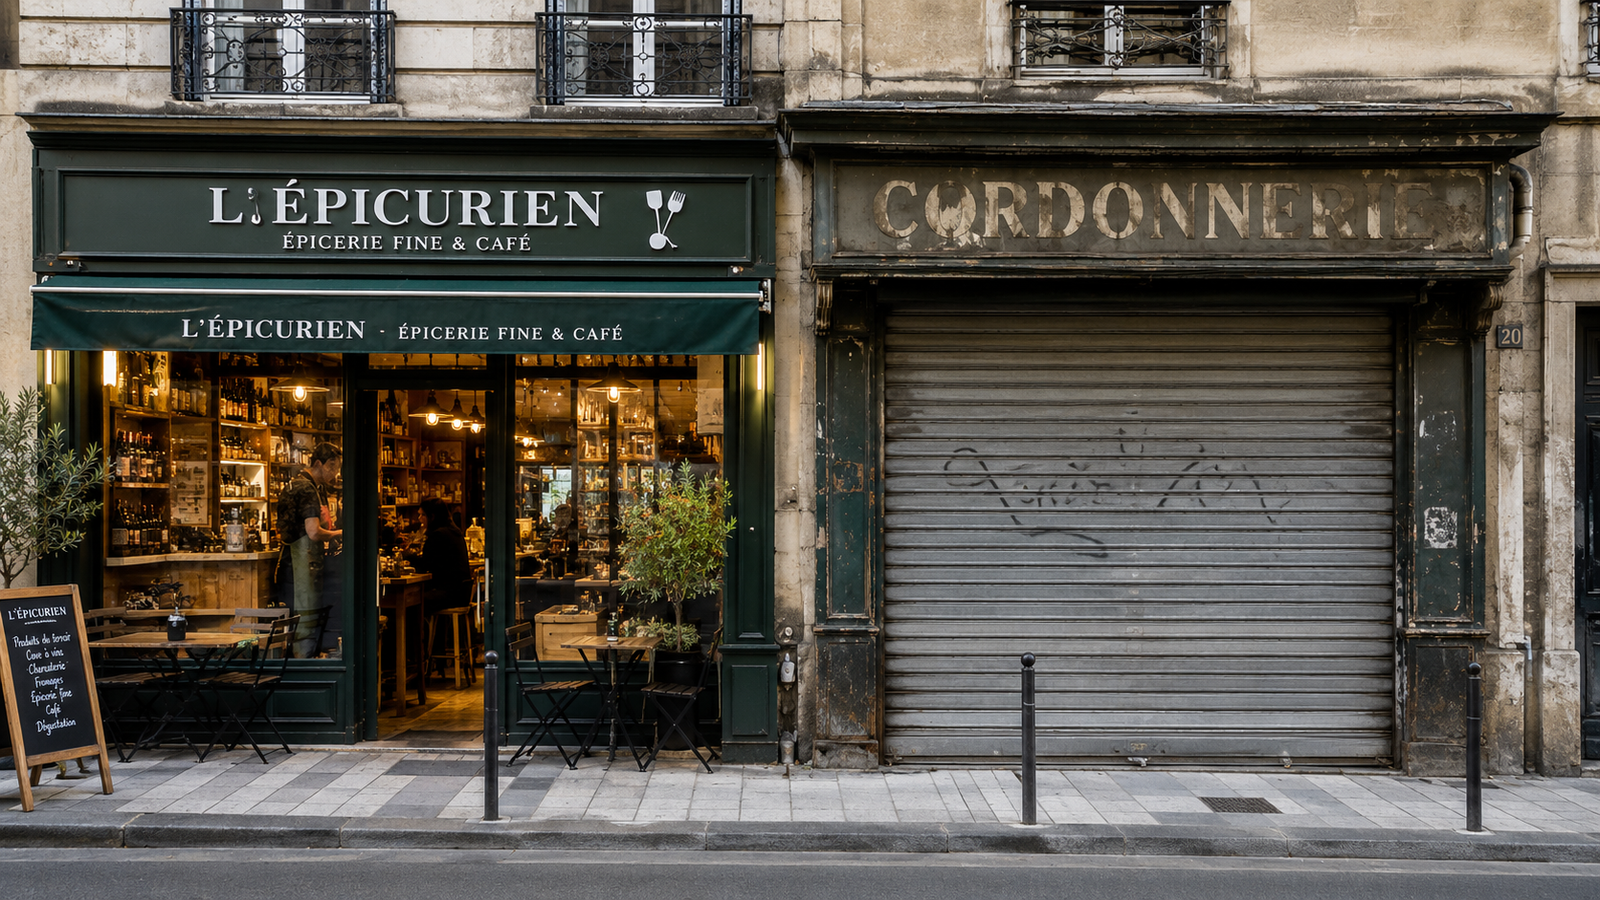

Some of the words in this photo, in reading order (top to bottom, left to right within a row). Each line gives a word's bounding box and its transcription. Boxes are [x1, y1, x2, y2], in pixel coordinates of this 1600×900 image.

[874, 180, 1435, 240] CORDONNERIE
[282, 231, 382, 250] ÉPICERIE
[393, 235, 443, 250] FINE
[452, 236, 466, 251] &
[476, 233, 531, 251] CAFÉ
[181, 314, 366, 339] L'ÉPICURIEN
[398, 322, 489, 340] ÉPICERIE
[498, 327, 543, 341] FINE
[552, 327, 564, 341] &
[573, 324, 623, 341] CAFÉ
[1501, 328, 1521, 345] 20
[8, 606, 67, 620] L'ÉPICURIEN
[12, 634, 40, 648] Produits
